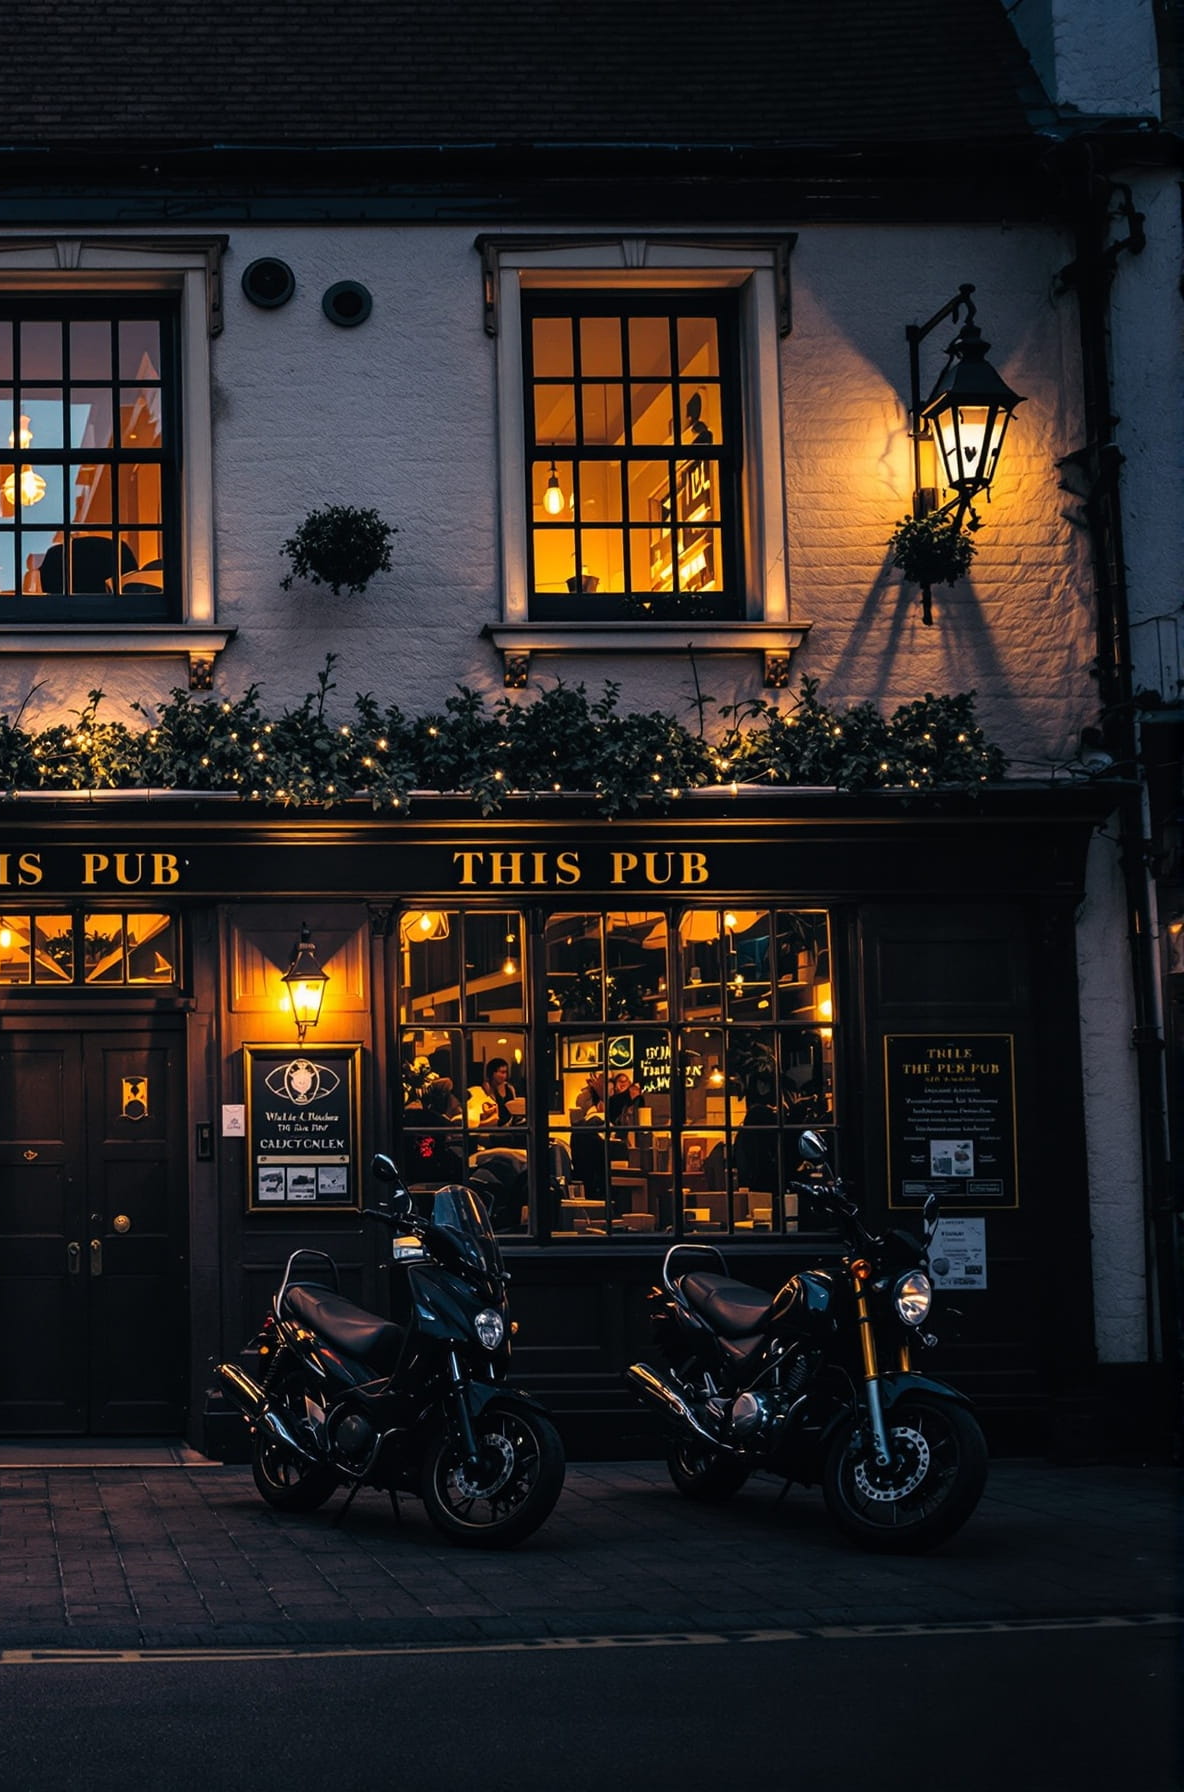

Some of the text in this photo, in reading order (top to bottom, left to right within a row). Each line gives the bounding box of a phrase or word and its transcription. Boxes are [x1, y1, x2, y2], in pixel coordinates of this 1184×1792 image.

[81, 853, 180, 885] PUB
[453, 851, 710, 885] THIS PUB
